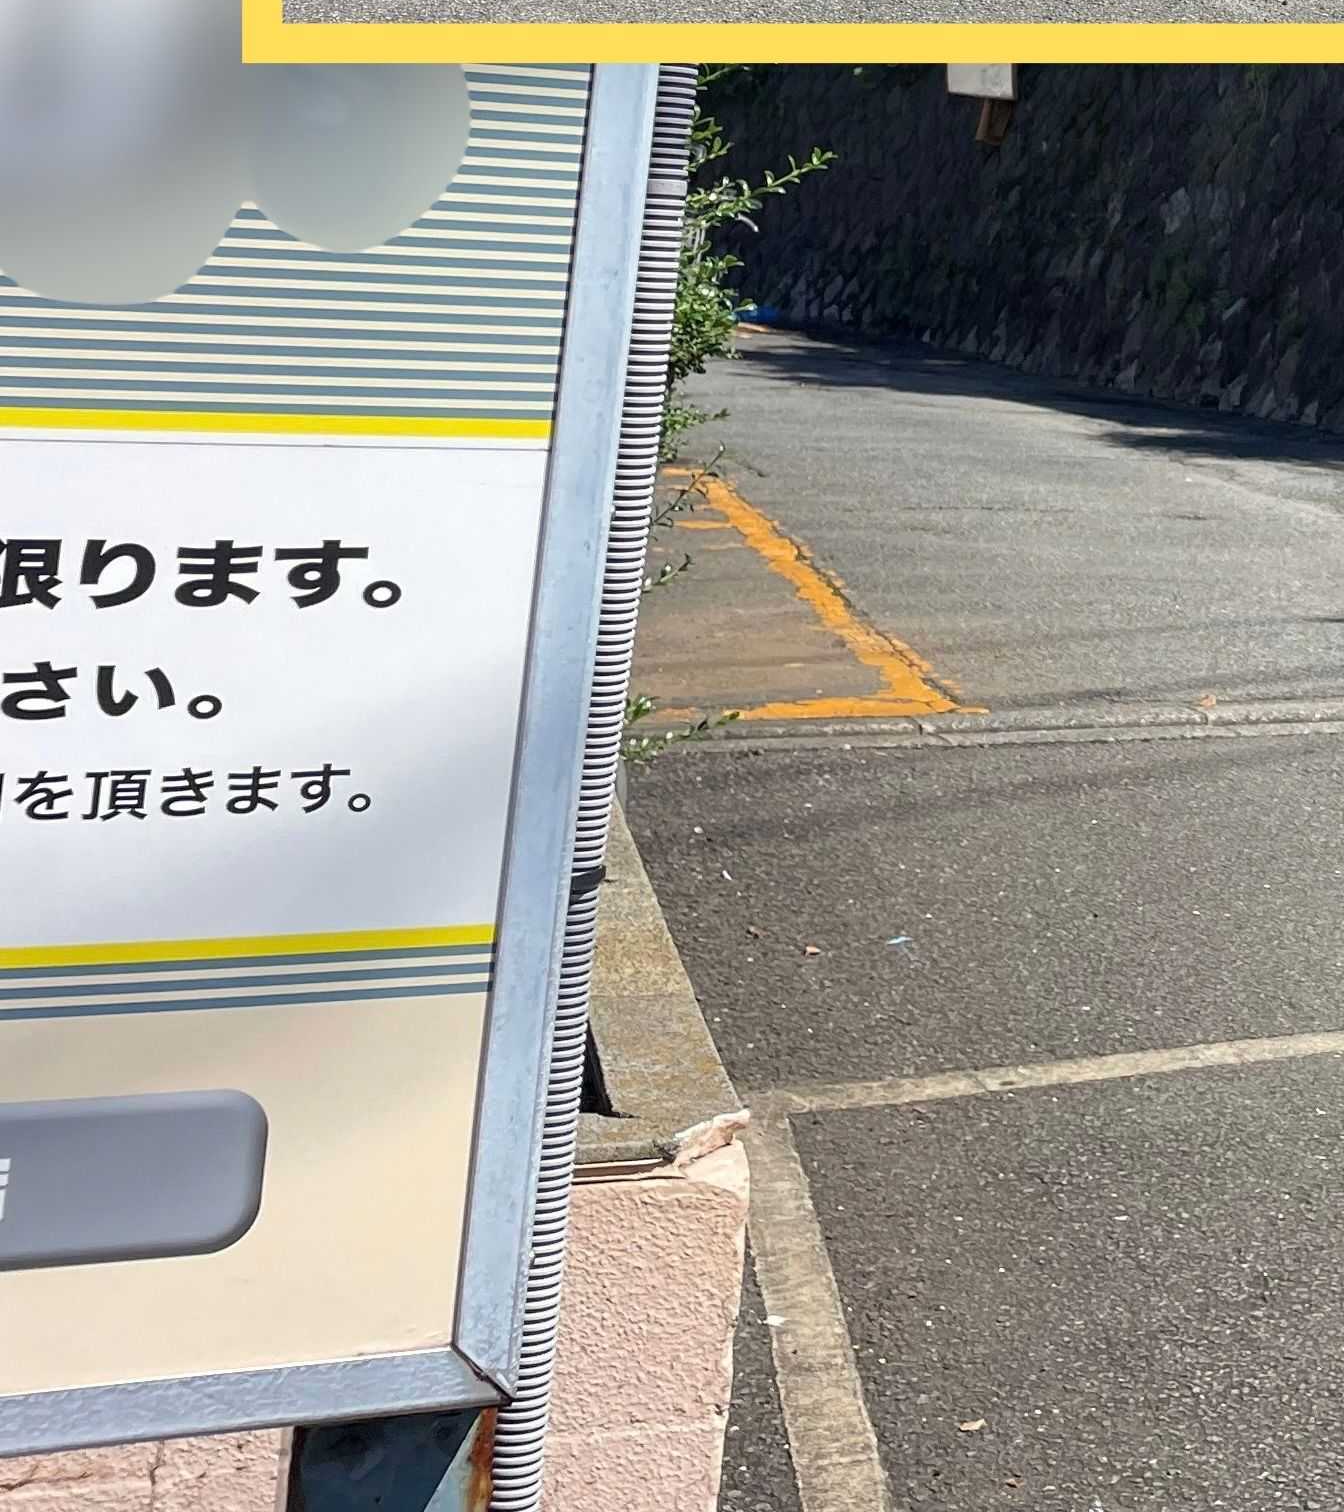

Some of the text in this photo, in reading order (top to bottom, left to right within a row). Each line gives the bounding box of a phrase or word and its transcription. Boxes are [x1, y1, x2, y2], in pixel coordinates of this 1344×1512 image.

[0, 661, 223, 720] さい。
[0, 763, 372, 821] を頂きます。
